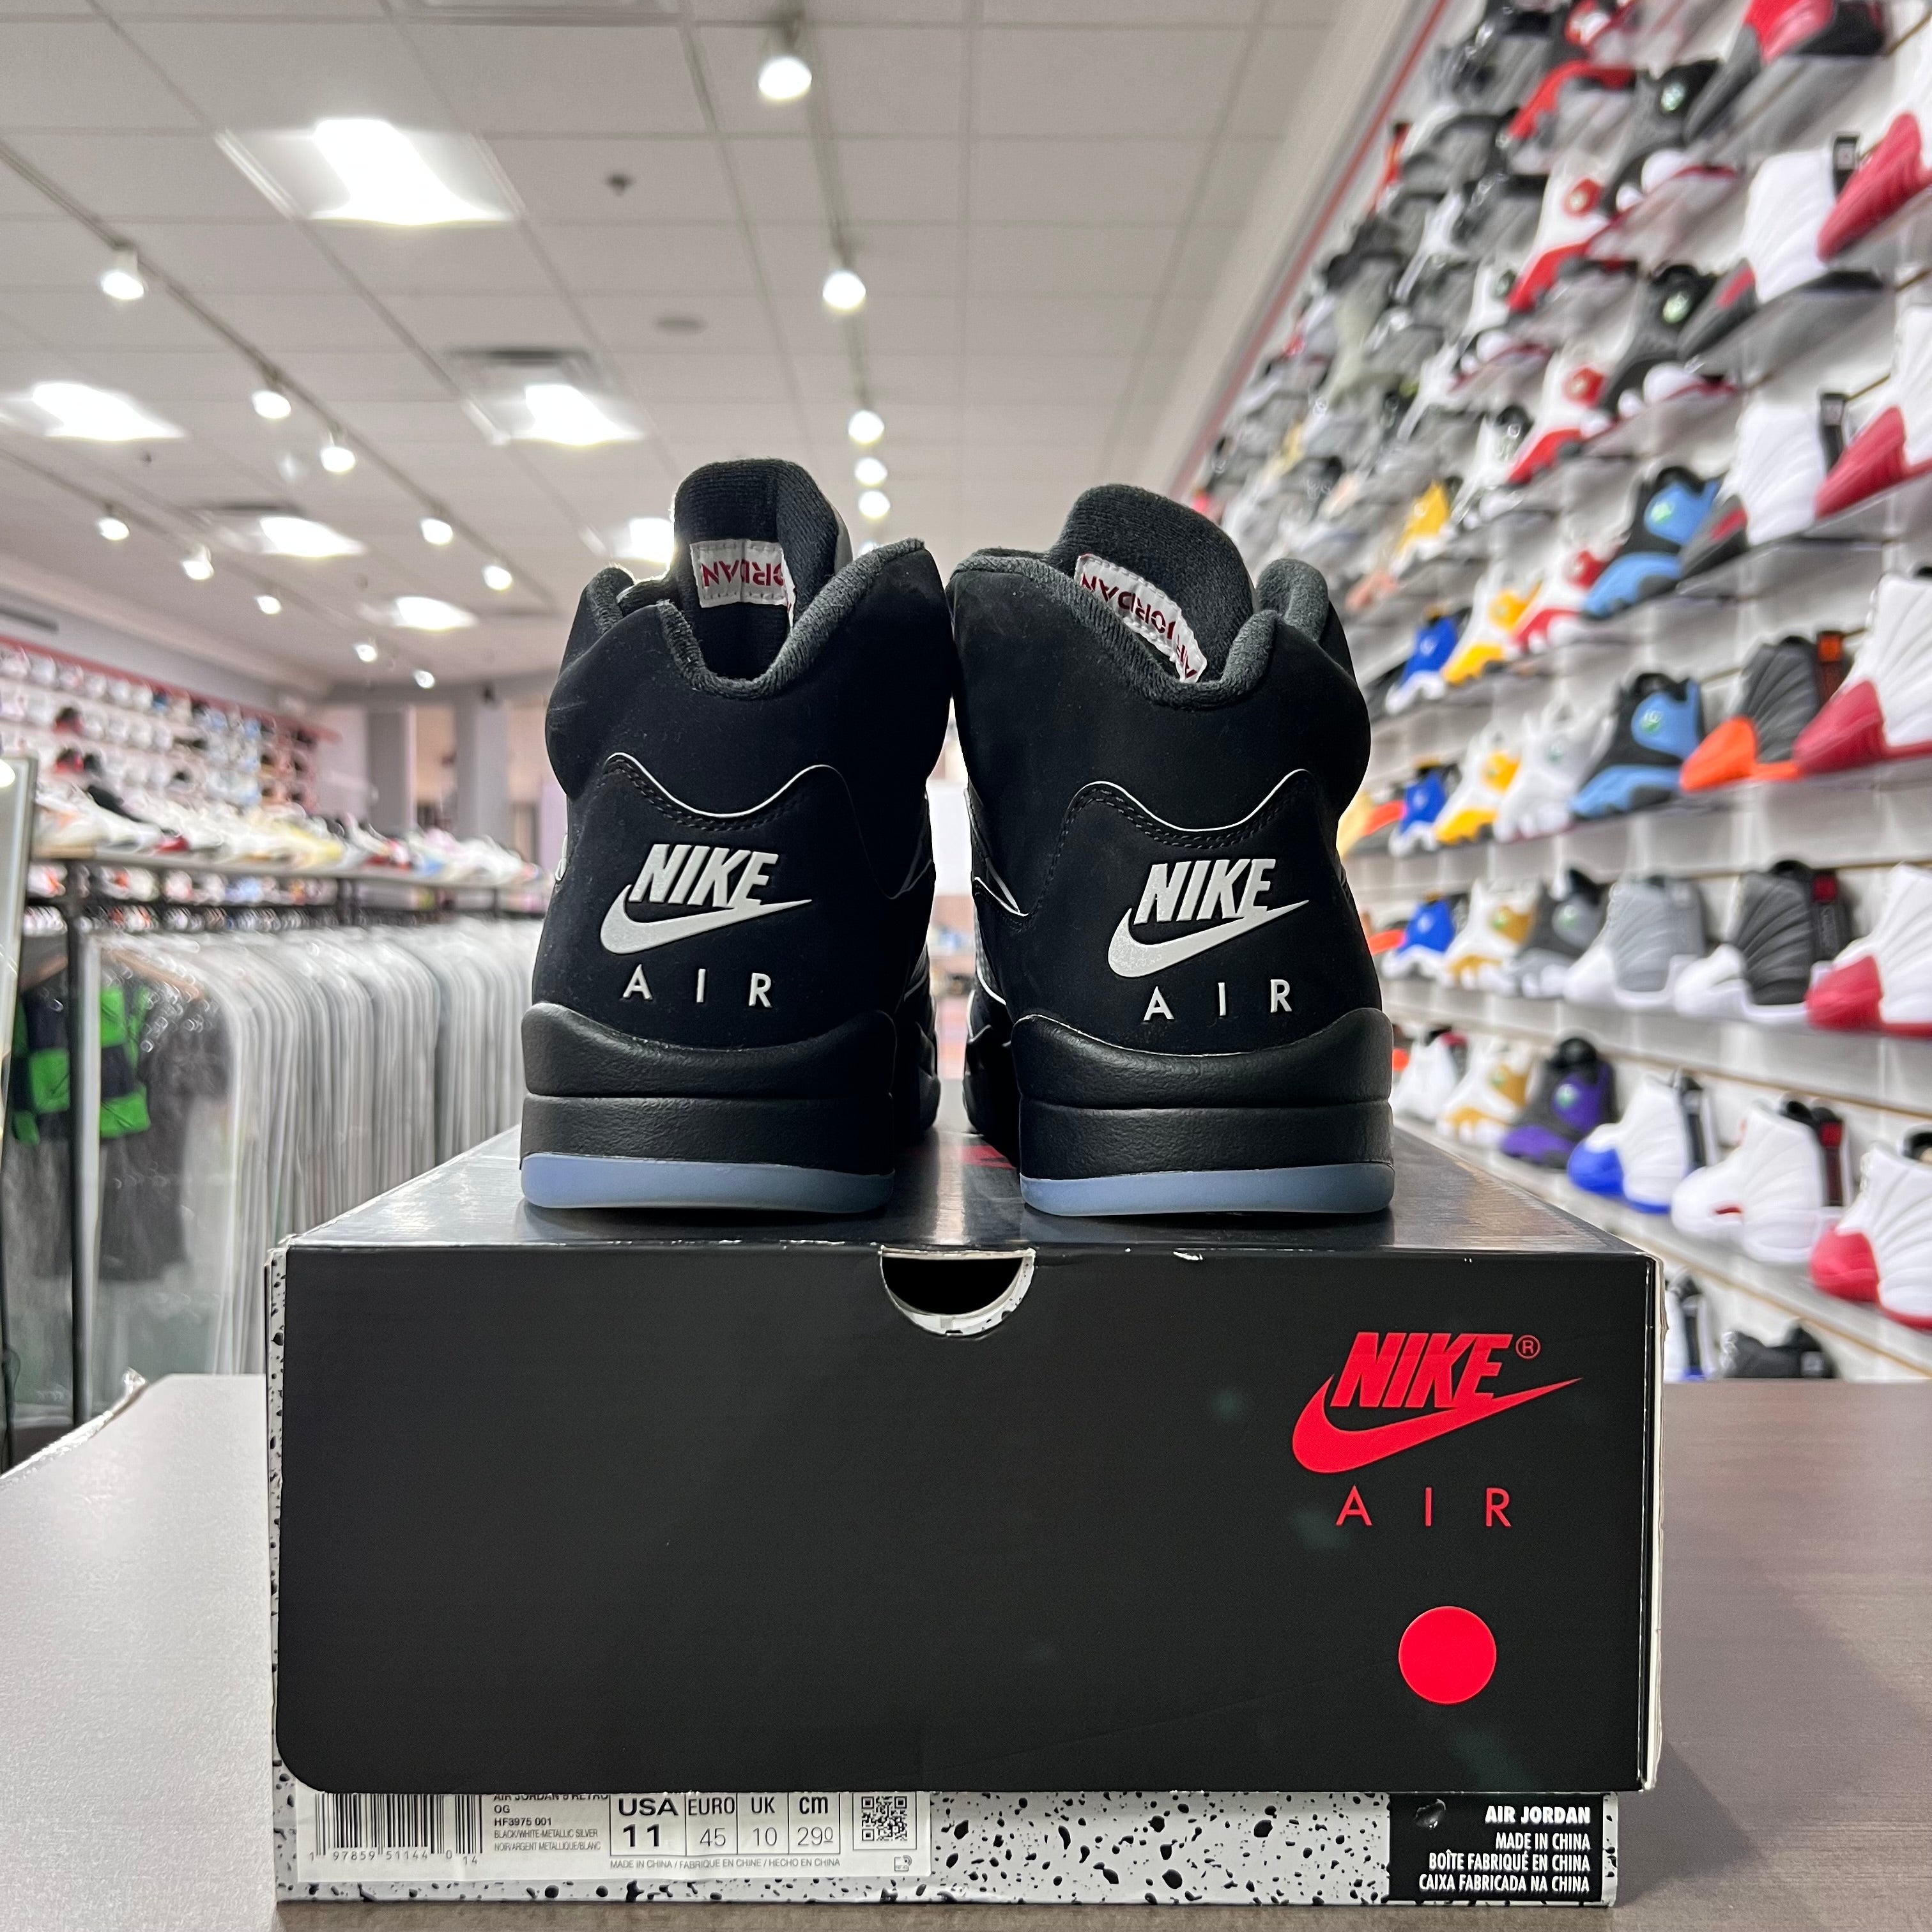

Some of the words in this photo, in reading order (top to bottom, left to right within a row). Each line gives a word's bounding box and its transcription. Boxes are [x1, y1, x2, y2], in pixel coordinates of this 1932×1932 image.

[702, 558, 785, 587] ORDAN
[629, 843, 779, 908] NIKE
[1133, 859, 1276, 926] NIKE
[622, 963, 772, 1008] AIR
[1143, 979, 1292, 1022] AIR
[1330, 1331, 1514, 1408] NIKE
[1335, 1484, 1512, 1528] AIR
[494, 1804, 510, 1813] OG
[618, 1797, 678, 1816] USA
[688, 1796, 736, 1815] EURO
[751, 1797, 775, 1814] UK
[799, 1796, 829, 1813] cm
[494, 1817, 532, 1826] HF3975
[534, 1817, 552, 1825] 001
[1485, 1805, 1516, 1823] AIR
[1521, 1807, 1590, 1824] JORDAN
[494, 1829, 574, 1838] BLACK/WHITE-METALLIC
[623, 1823, 659, 1847] 11
[700, 1828, 726, 1846] 45
[753, 1827, 778, 1846] 10
[1496, 1832, 1531, 1850] MADE
[1535, 1833, 1548, 1850] IN
[1552, 1833, 1590, 1850] CHINA
[309, 1852, 315, 1862] 1
[333, 1851, 376, 1860] 97859
[385, 1850, 428, 1860] 51144
[446, 1850, 452, 1859] 0
[463, 1855, 478, 1864] 14
[610, 1860, 634, 1868] MADE
[647, 1860, 672, 1868] CHINA
[679, 1859, 720, 1869] FABRIQUE
[736, 1859, 762, 1867] CHINE
[769, 1858, 799, 1867] HECHO
[814, 1858, 841, 1866] CHINA
[1429, 1849, 1464, 1870] BOÎTE
[1468, 1850, 1528, 1871] FABRIQUÉ
[1533, 1855, 1547, 1871] EN
[1552, 1855, 1590, 1871] CHINA
[1419, 1874, 1455, 1891] CAIXA
[1459, 1875, 1526, 1892] FABRICADA
[1530, 1876, 1547, 1892] NA
[1552, 1876, 1590, 1892] CHINA
